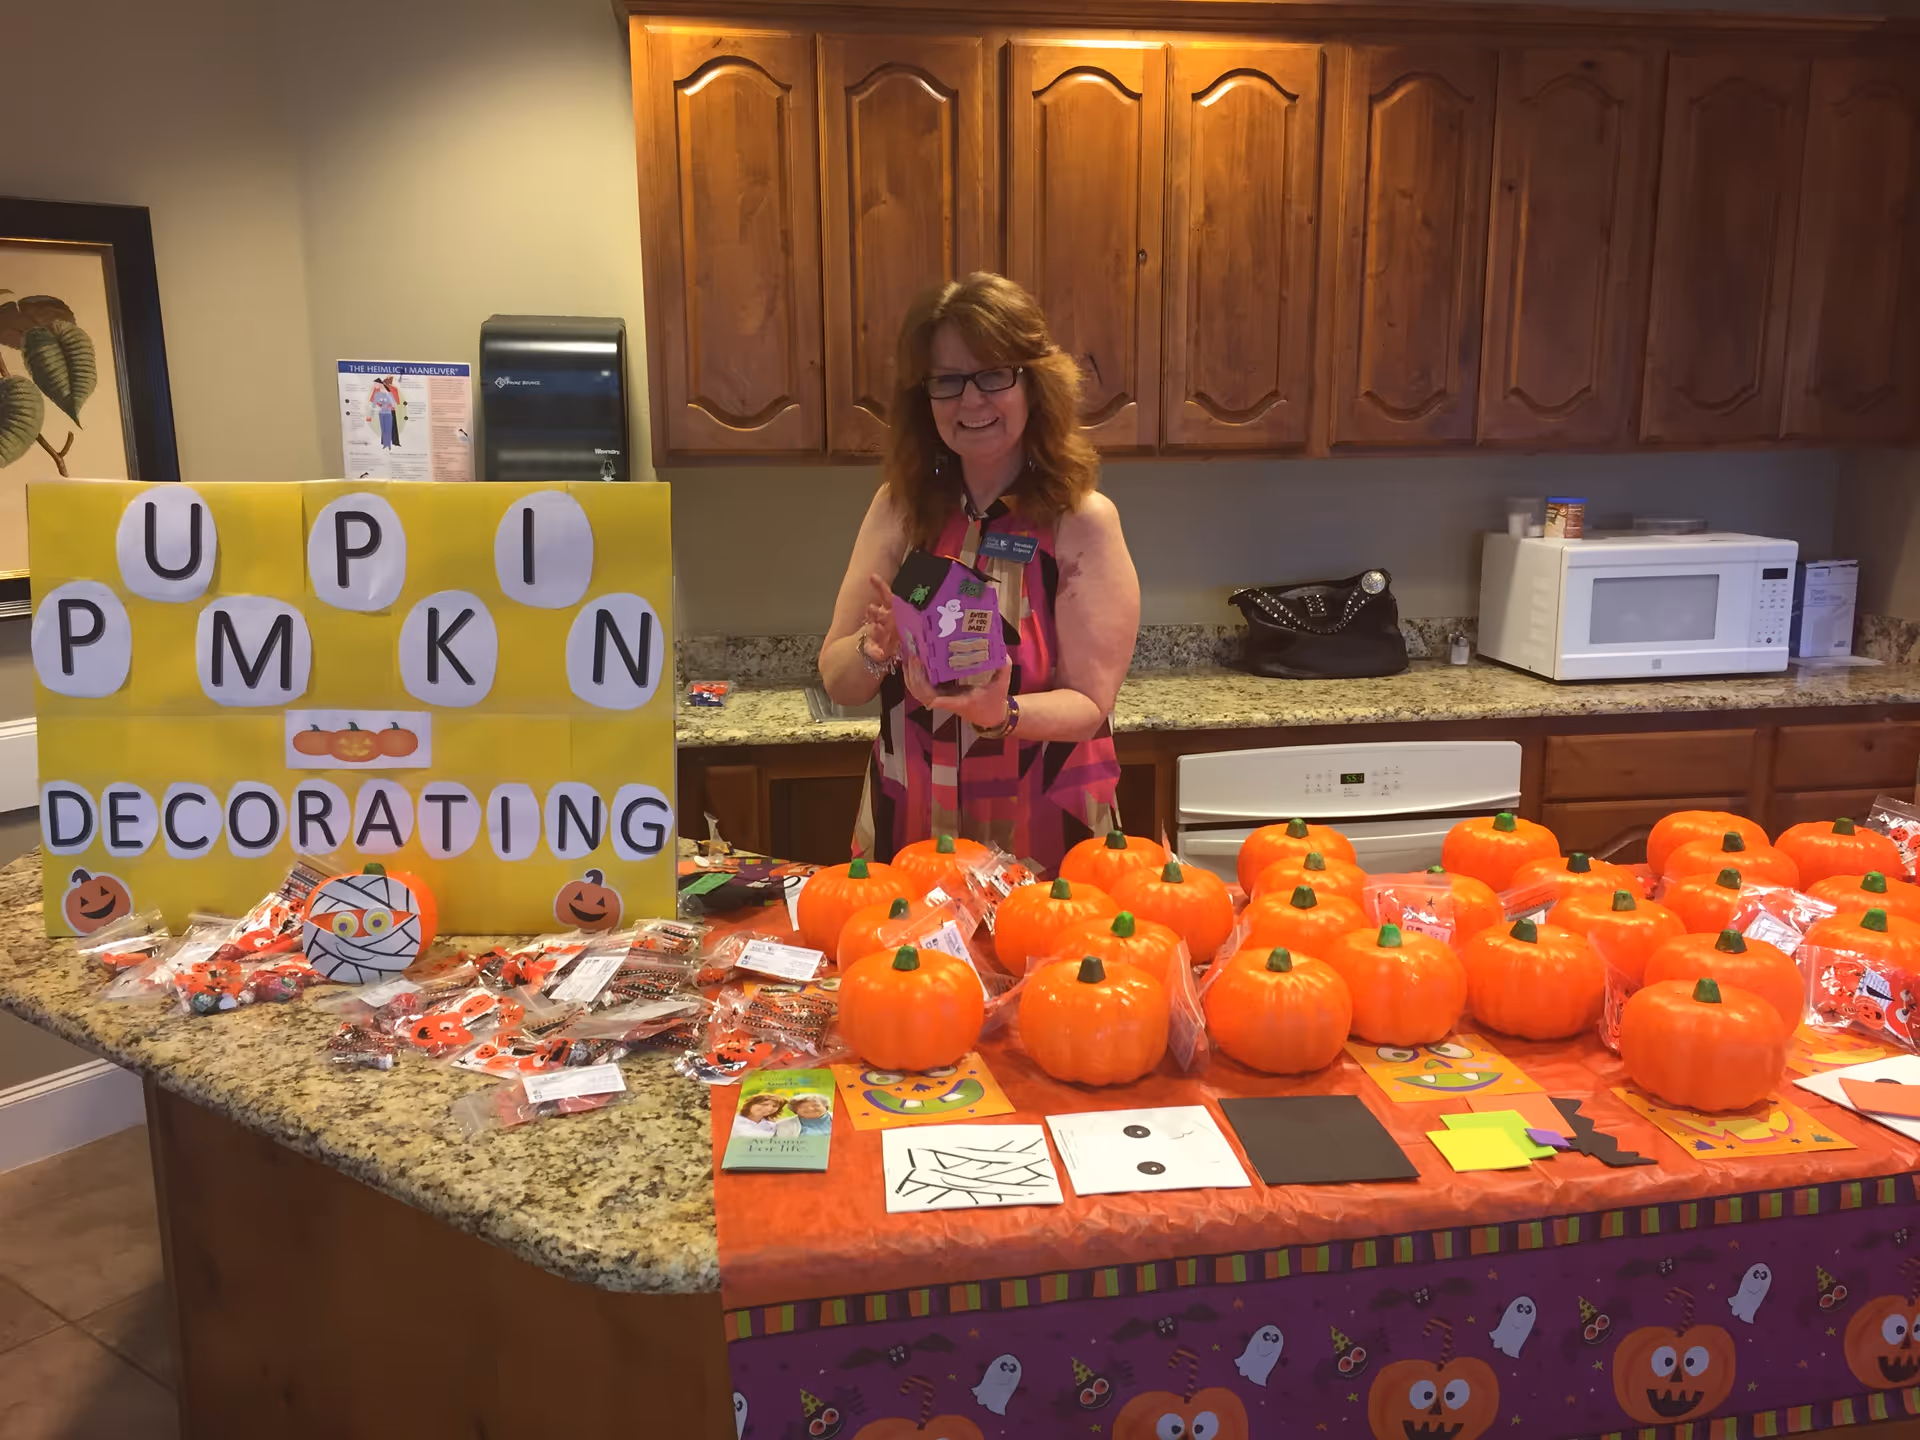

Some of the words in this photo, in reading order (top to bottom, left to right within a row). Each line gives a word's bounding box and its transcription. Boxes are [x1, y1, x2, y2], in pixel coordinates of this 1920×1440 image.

[348, 364, 364, 373] THE
[969, 611, 988, 619] ENTER
[47, 789, 669, 854] DECORATING
